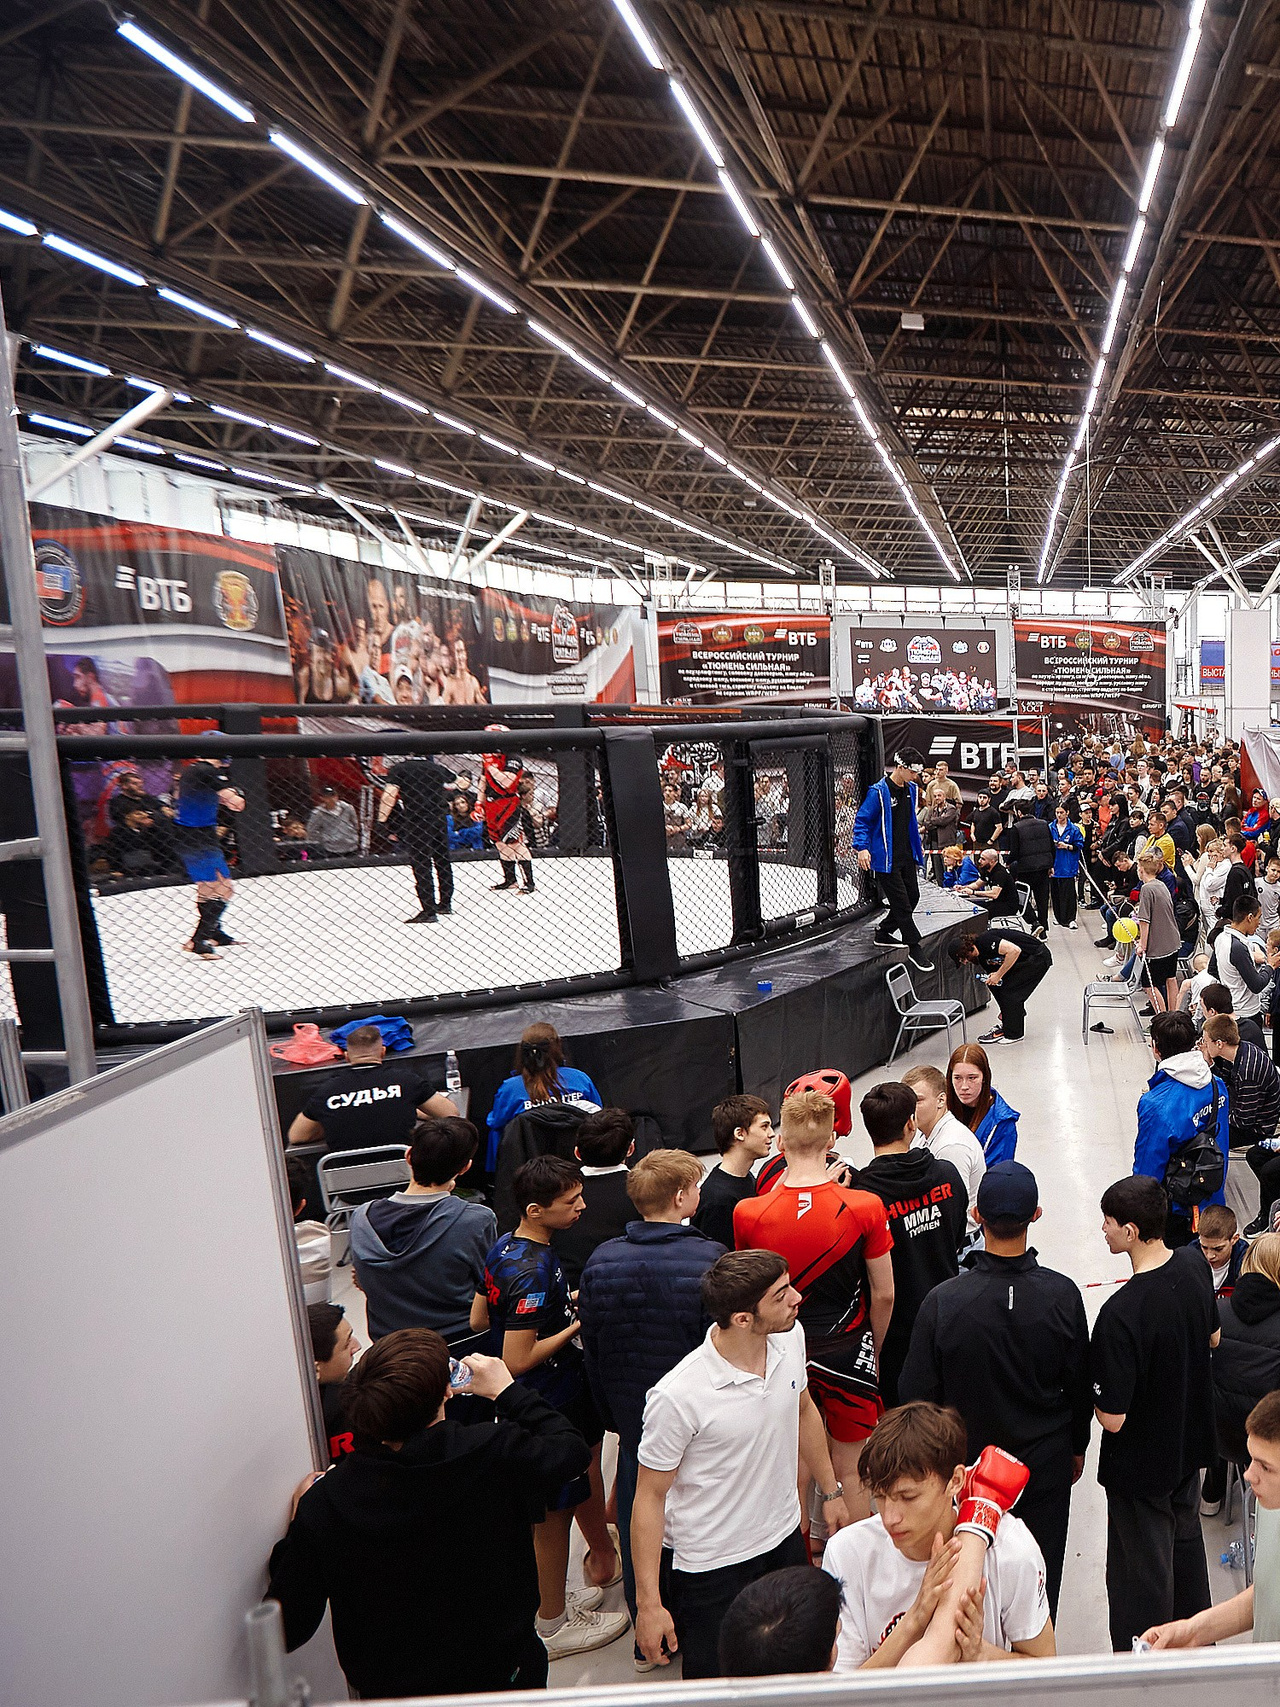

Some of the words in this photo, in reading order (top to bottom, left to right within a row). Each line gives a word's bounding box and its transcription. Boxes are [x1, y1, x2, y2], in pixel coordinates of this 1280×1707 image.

[137, 575, 193, 613] ВТБ
[788, 631, 818, 647] ВТБ
[1040, 635, 1067, 649] ВТБ
[692, 650, 766, 661] ВСЕРОССИЙСКИЙ
[766, 652, 800, 661] ТУРНИР
[1044, 656, 1108, 665] ВСЕРОССИЙСКИЙ
[1109, 657, 1139, 665] ТУРНИР
[702, 662, 745, 671] «ТЮМЕНЬ
[745, 662, 791, 672] СИЛЬНАЯ»
[1091, 666, 1131, 674] СИЛЬНАЯ»
[326, 1084, 402, 1110] СУДЬЯ
[886, 1182, 953, 1220] HUNTER
[903, 1204, 942, 1231] MMA
[909, 1219, 940, 1238] TYUMEN
